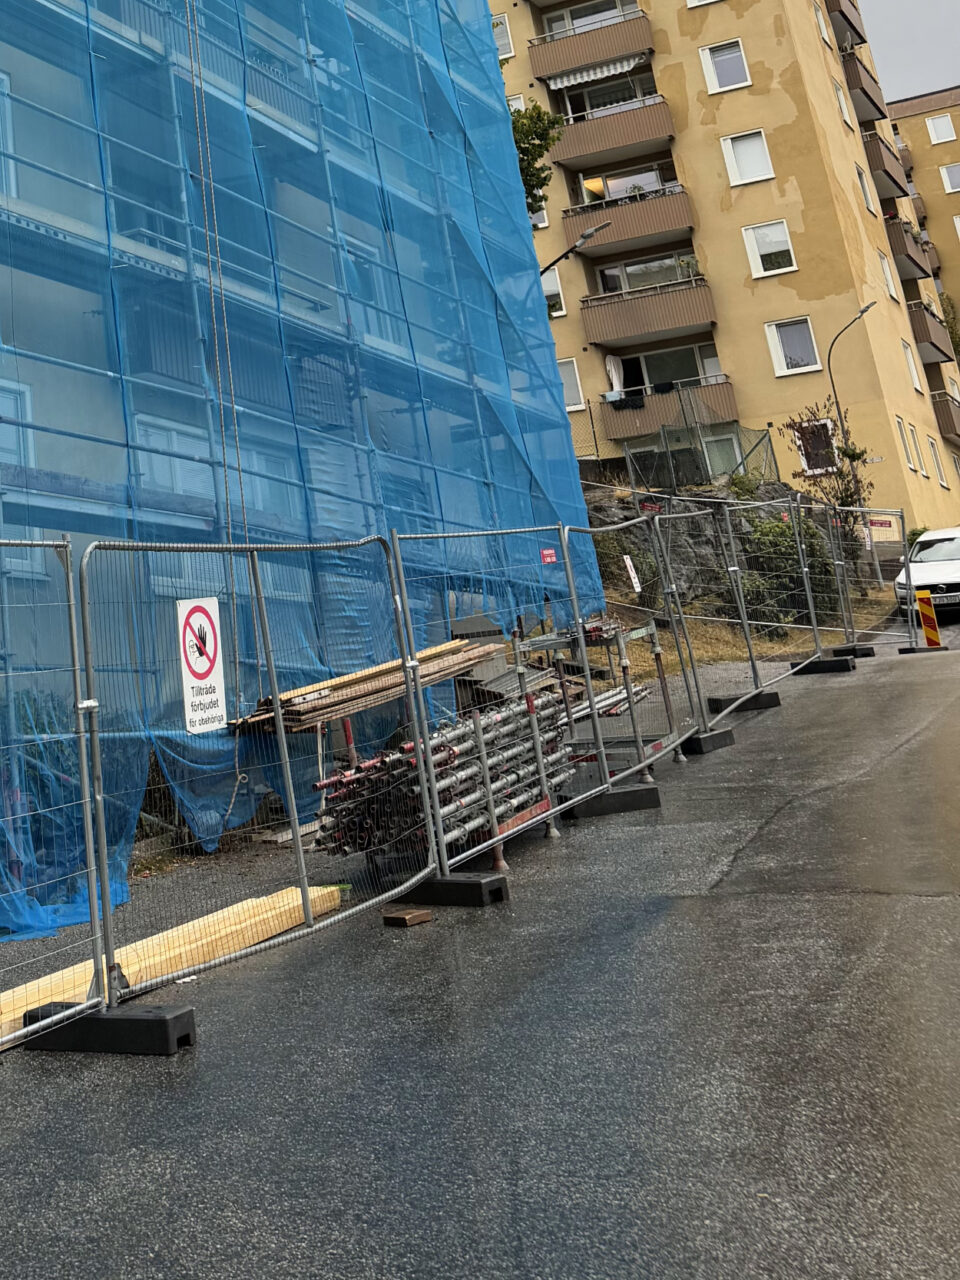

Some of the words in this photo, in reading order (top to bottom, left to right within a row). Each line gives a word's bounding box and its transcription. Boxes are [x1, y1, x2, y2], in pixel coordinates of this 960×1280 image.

[191, 684, 216, 698] Tillträde
[190, 699, 219, 713] förbjudet
[189, 718, 197, 728] för
